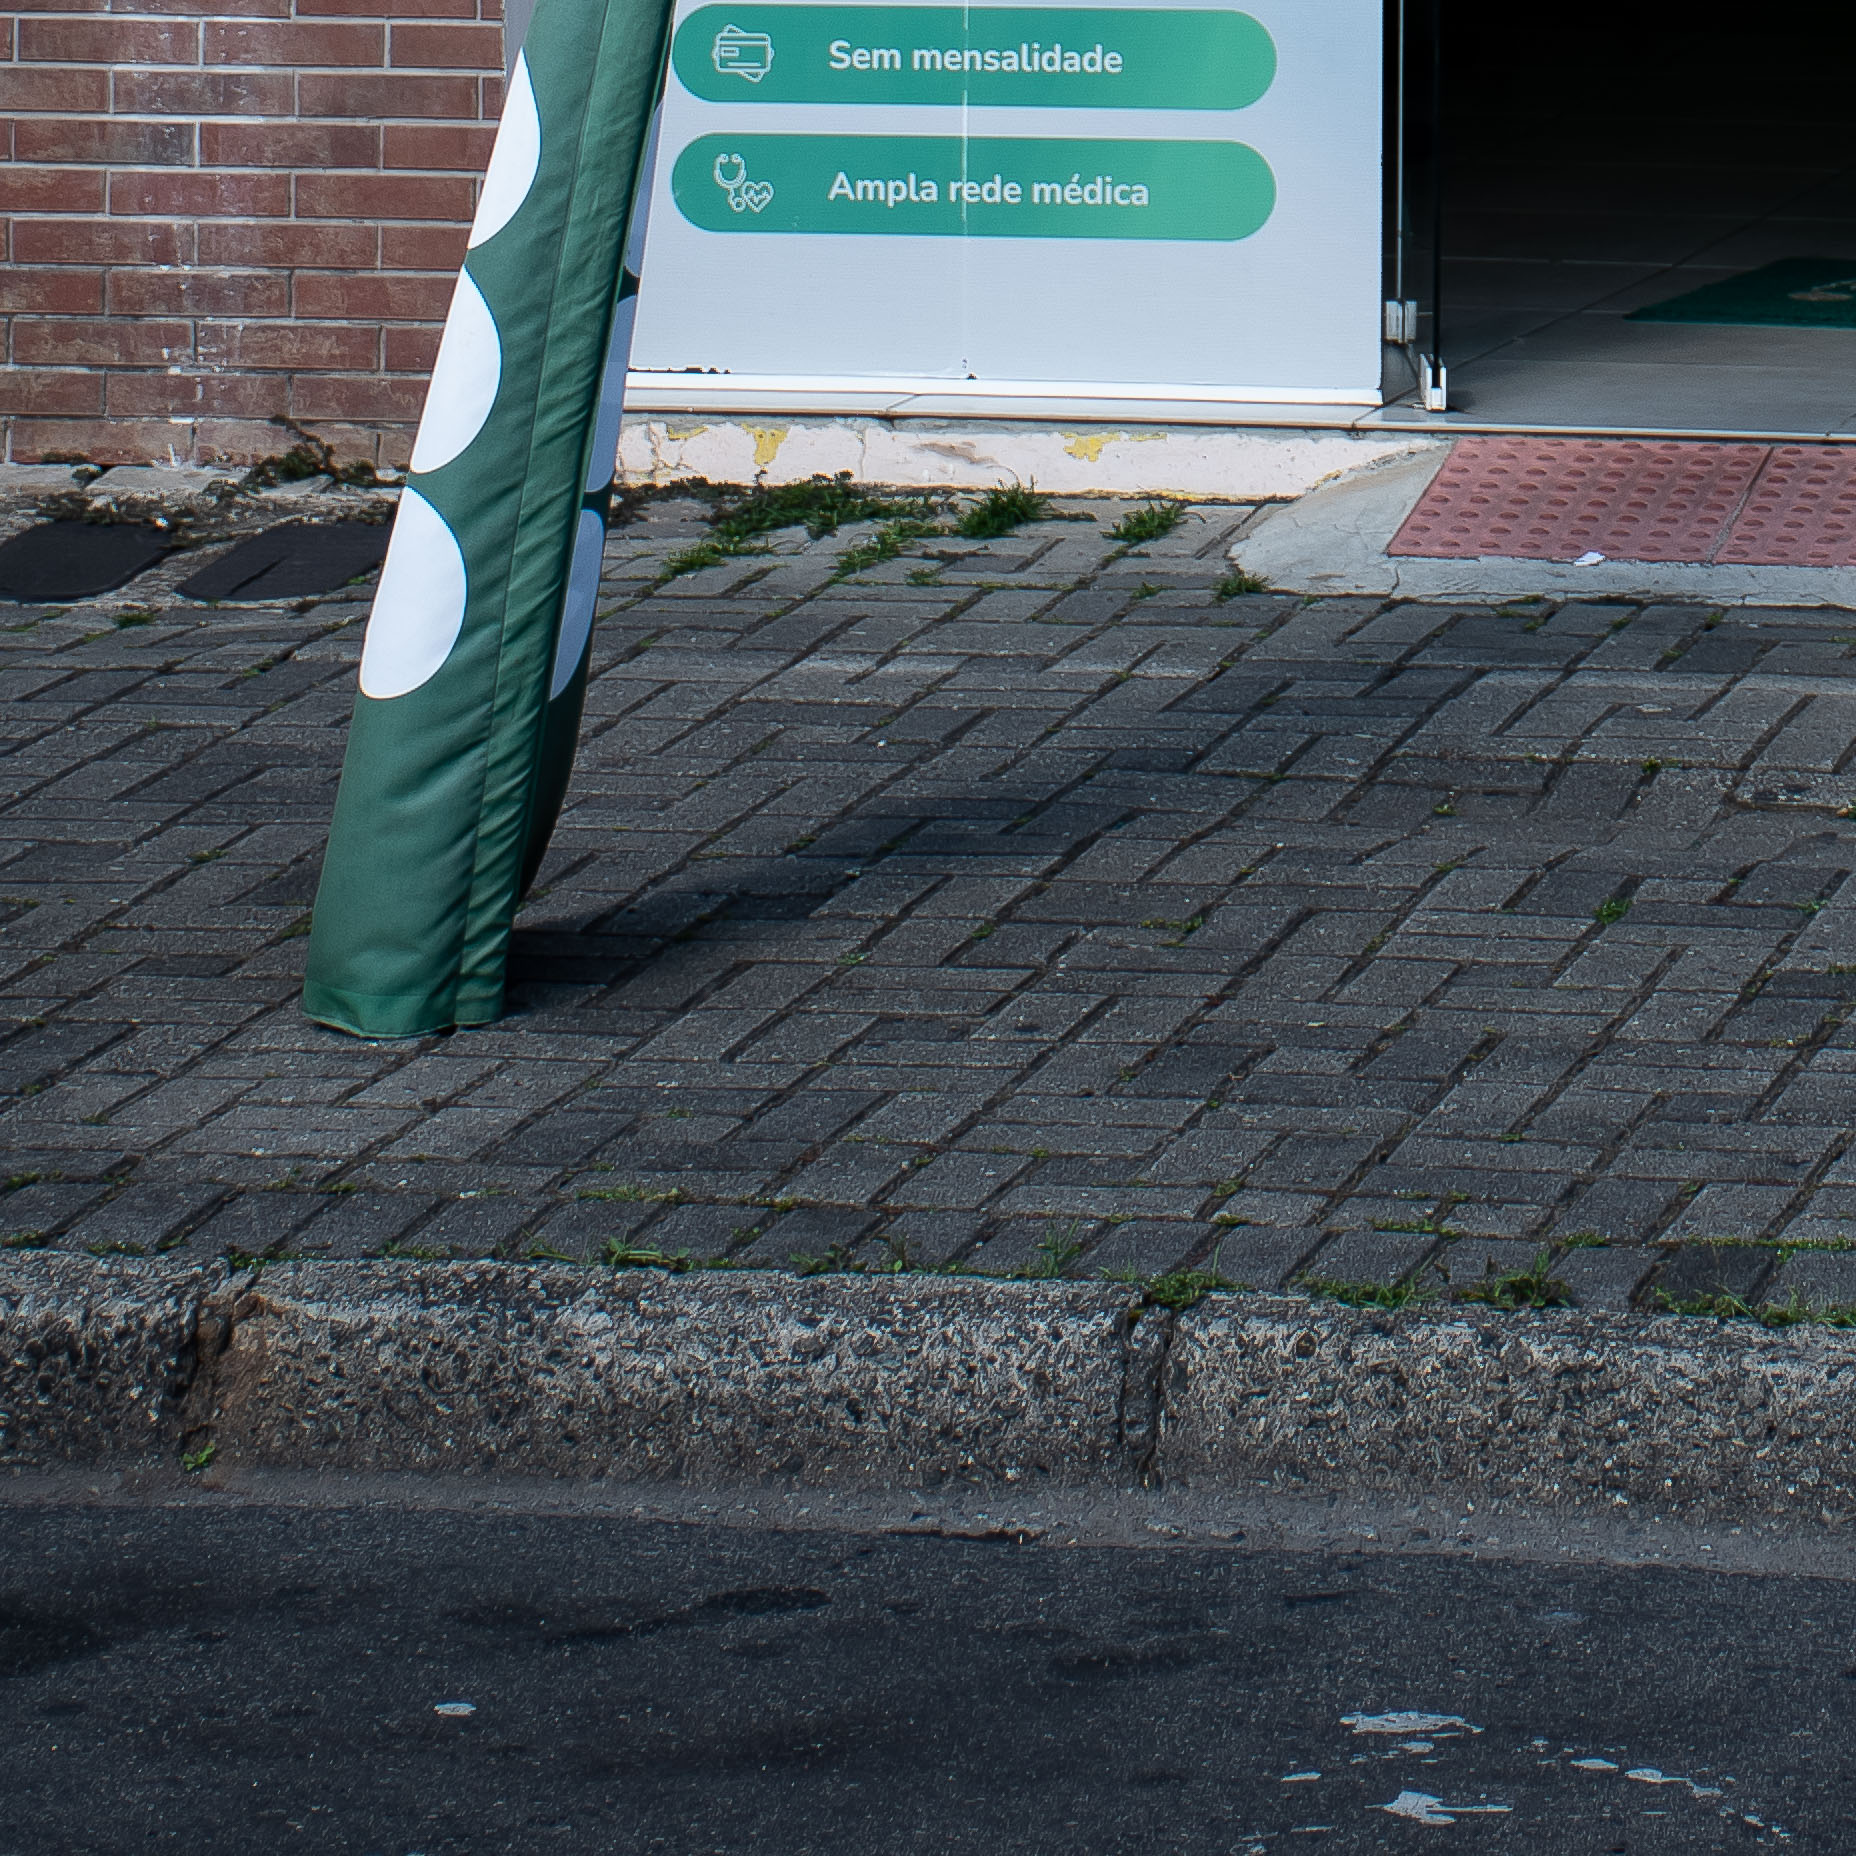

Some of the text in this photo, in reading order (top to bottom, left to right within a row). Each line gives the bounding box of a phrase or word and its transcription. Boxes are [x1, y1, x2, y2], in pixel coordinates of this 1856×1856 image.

[829, 40, 1123, 74] Sem mensalidade
[829, 171, 1150, 208] Ampla rede médica
